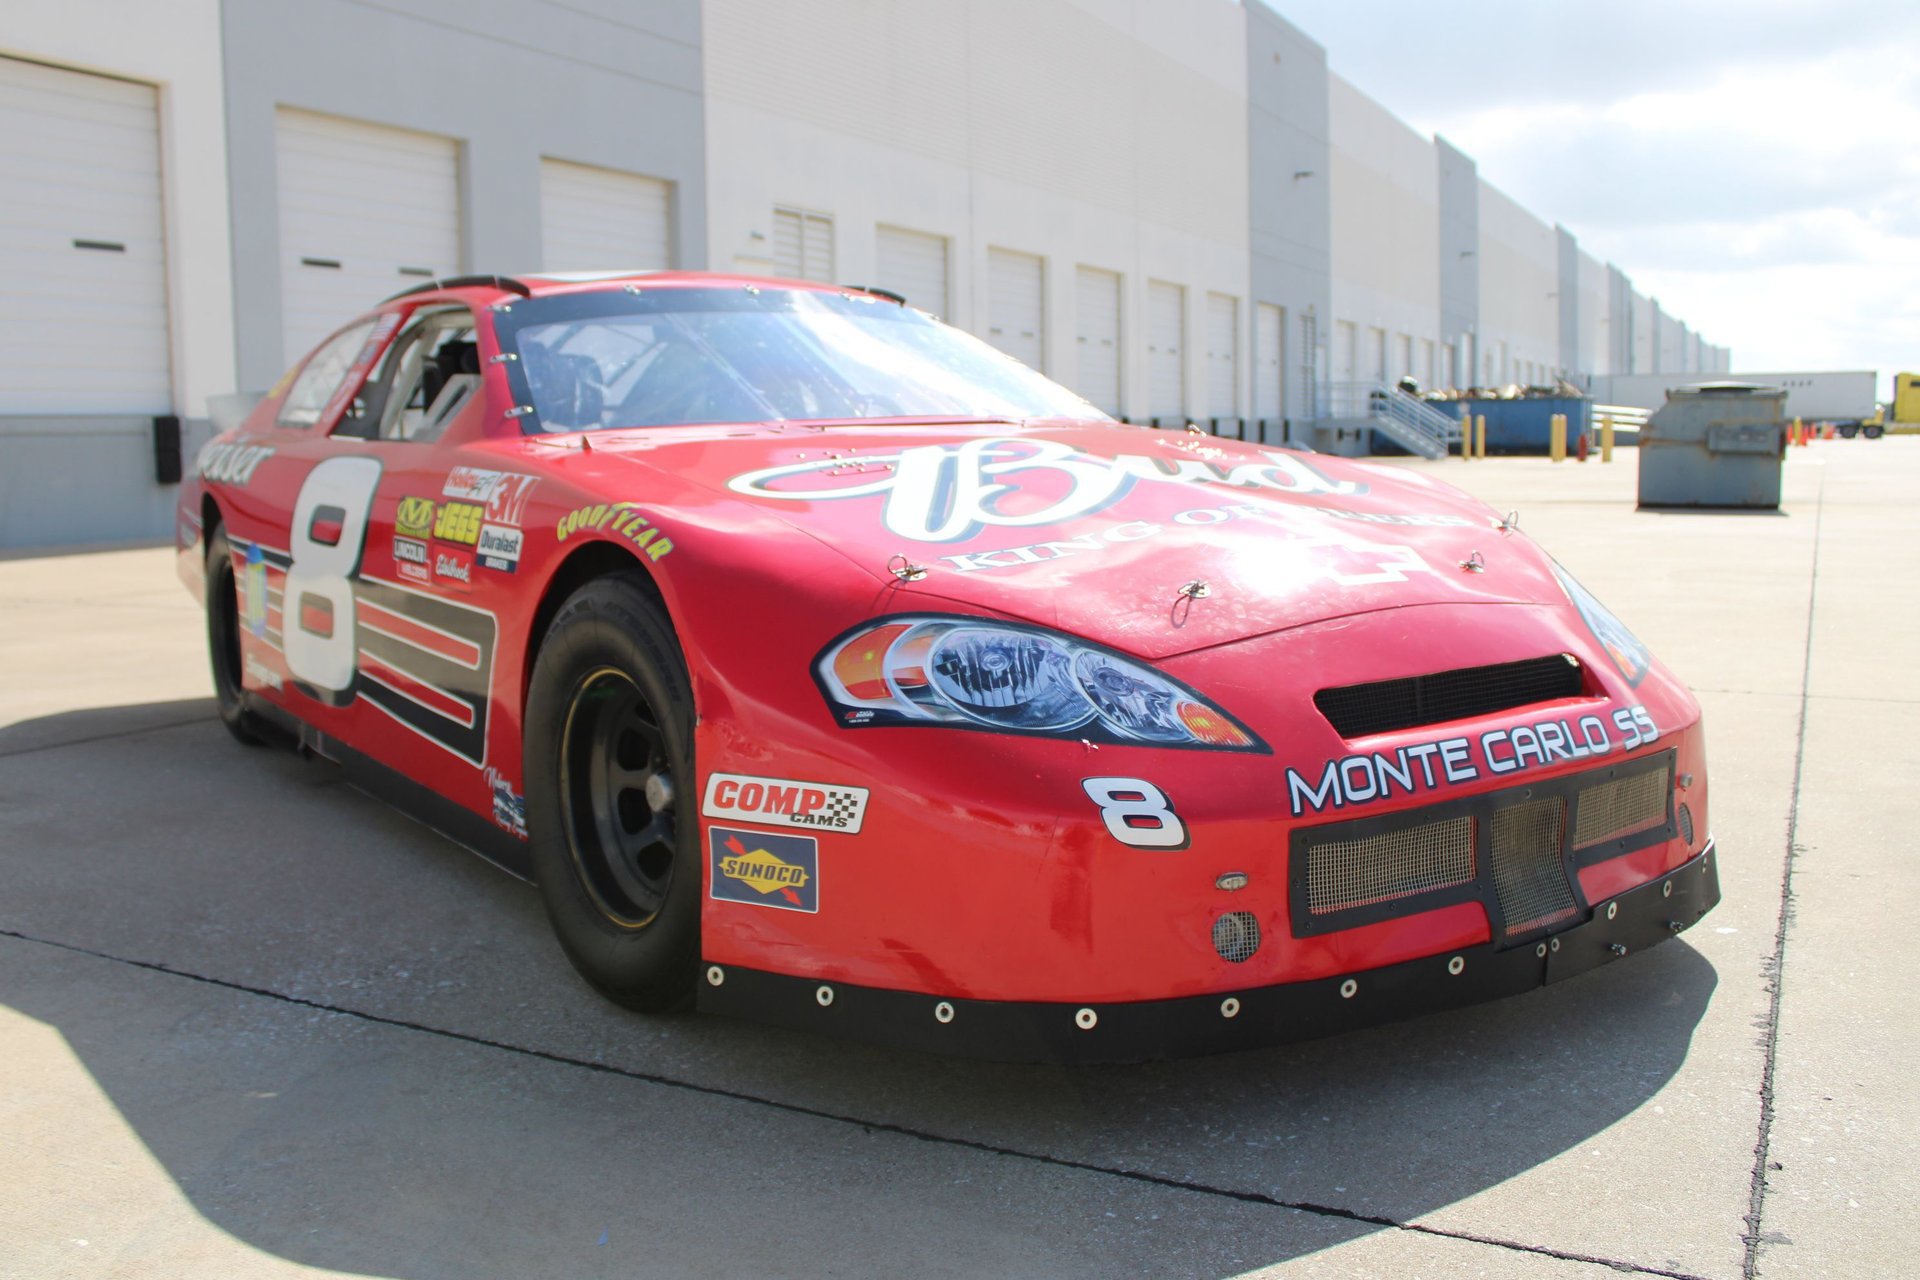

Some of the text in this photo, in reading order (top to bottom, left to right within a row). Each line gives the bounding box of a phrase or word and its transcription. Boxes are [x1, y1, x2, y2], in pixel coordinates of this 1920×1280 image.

[726, 437, 1370, 544] Bud
[433, 501, 484, 545] JEGS
[480, 529, 519, 555] Duralast
[557, 502, 674, 562] GOODYEAR
[940, 520, 1164, 573] KING
[283, 455, 384, 708] 8
[1286, 705, 1660, 815] MONTE CARLO SS
[713, 780, 826, 816] COMP
[789, 813, 848, 829] CAMS
[1080, 776, 1191, 850] 8
[725, 859, 804, 884] SUNOCO
